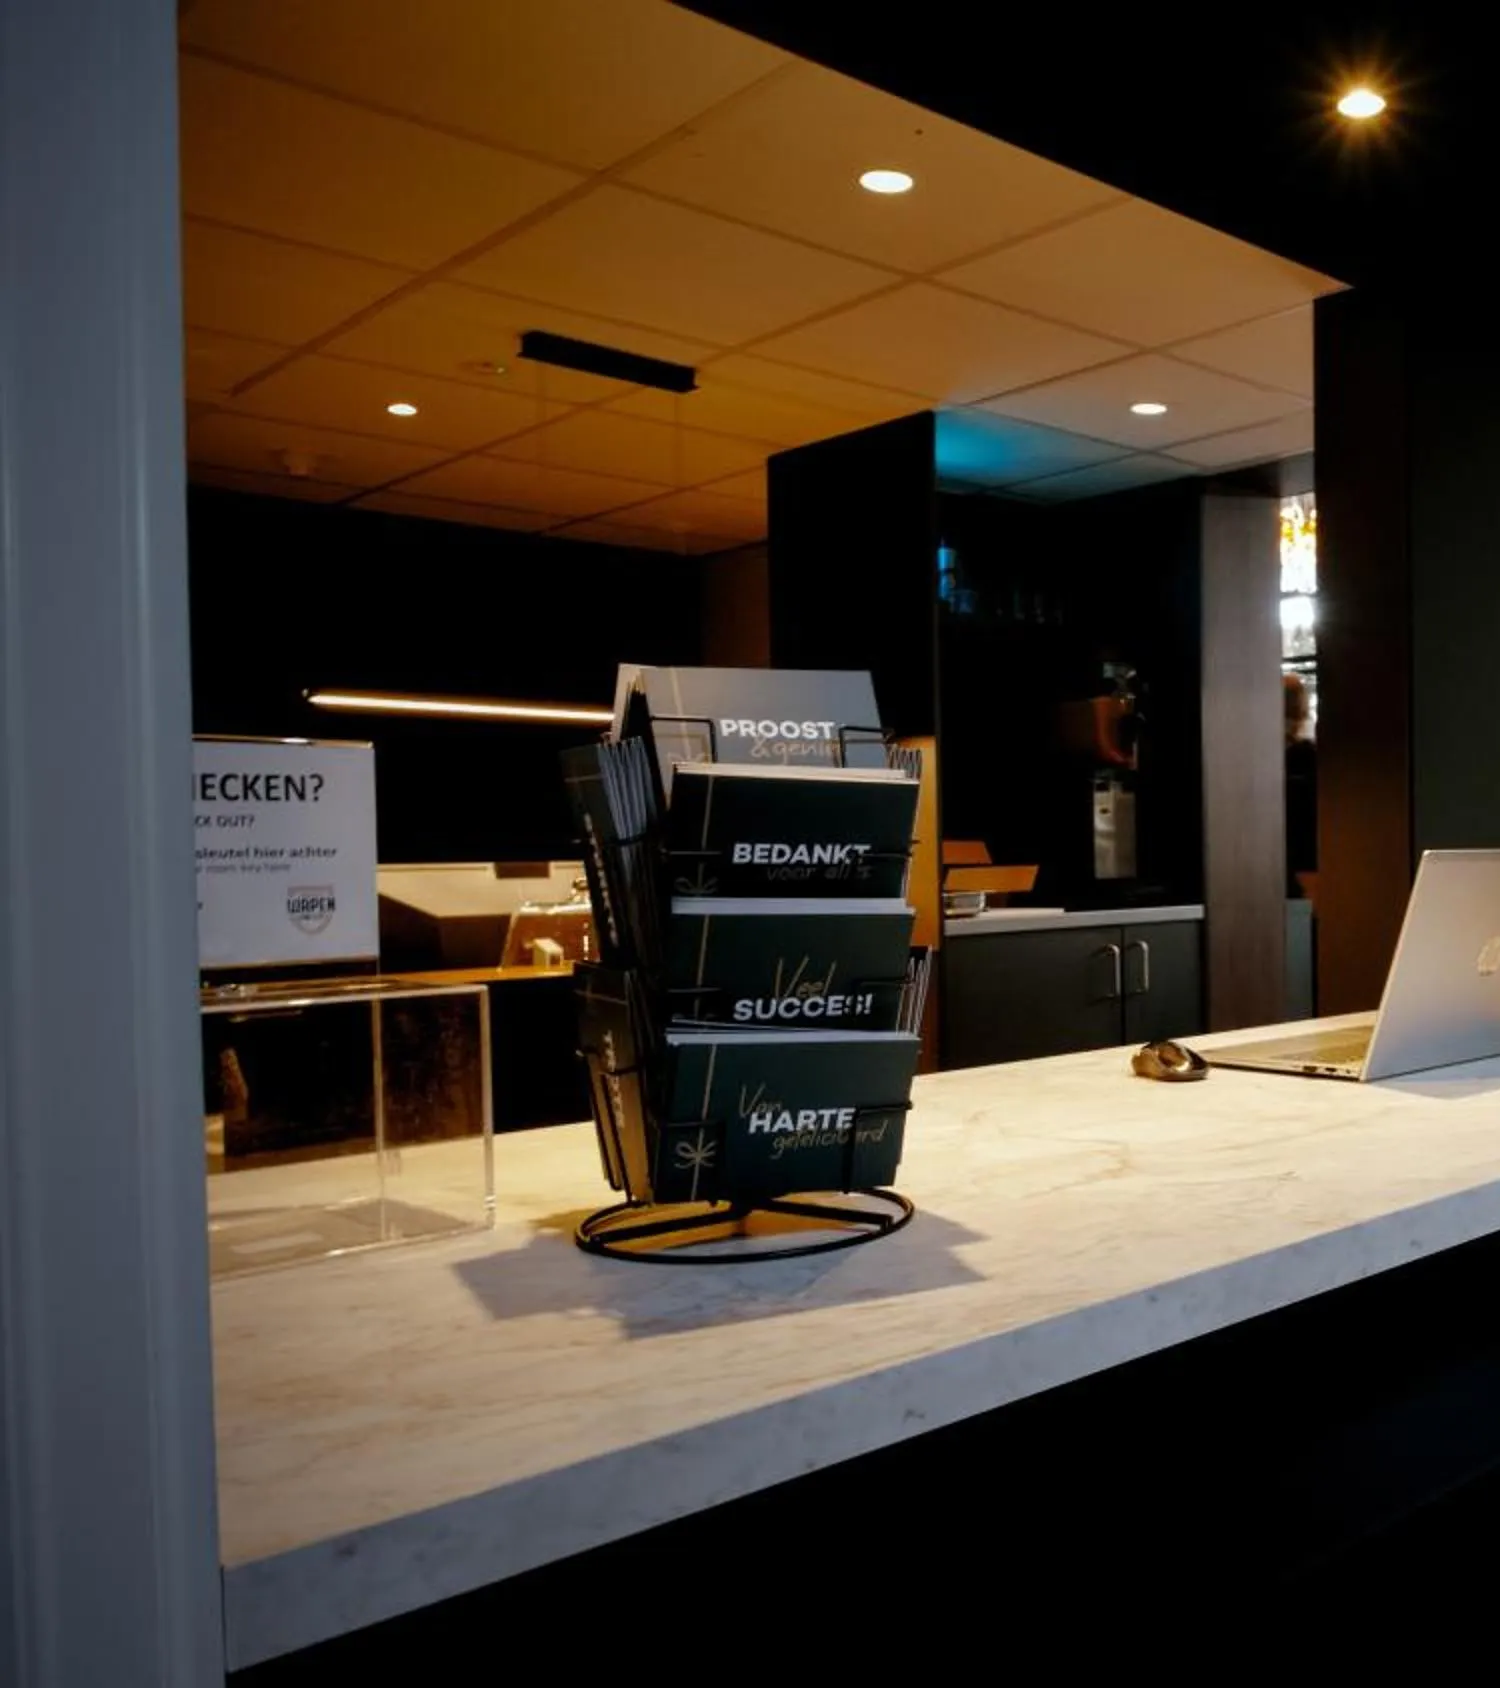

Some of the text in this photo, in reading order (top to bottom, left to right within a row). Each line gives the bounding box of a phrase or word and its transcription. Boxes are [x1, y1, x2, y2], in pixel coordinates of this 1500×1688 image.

[719, 718, 836, 740] PROOST
[193, 772, 325, 803] ECKEN?
[216, 815, 255, 829] OUT?
[253, 847, 285, 859] hier
[289, 846, 338, 859] achter
[731, 841, 873, 866] BEDANKT
[748, 1106, 858, 1135] HARTE
